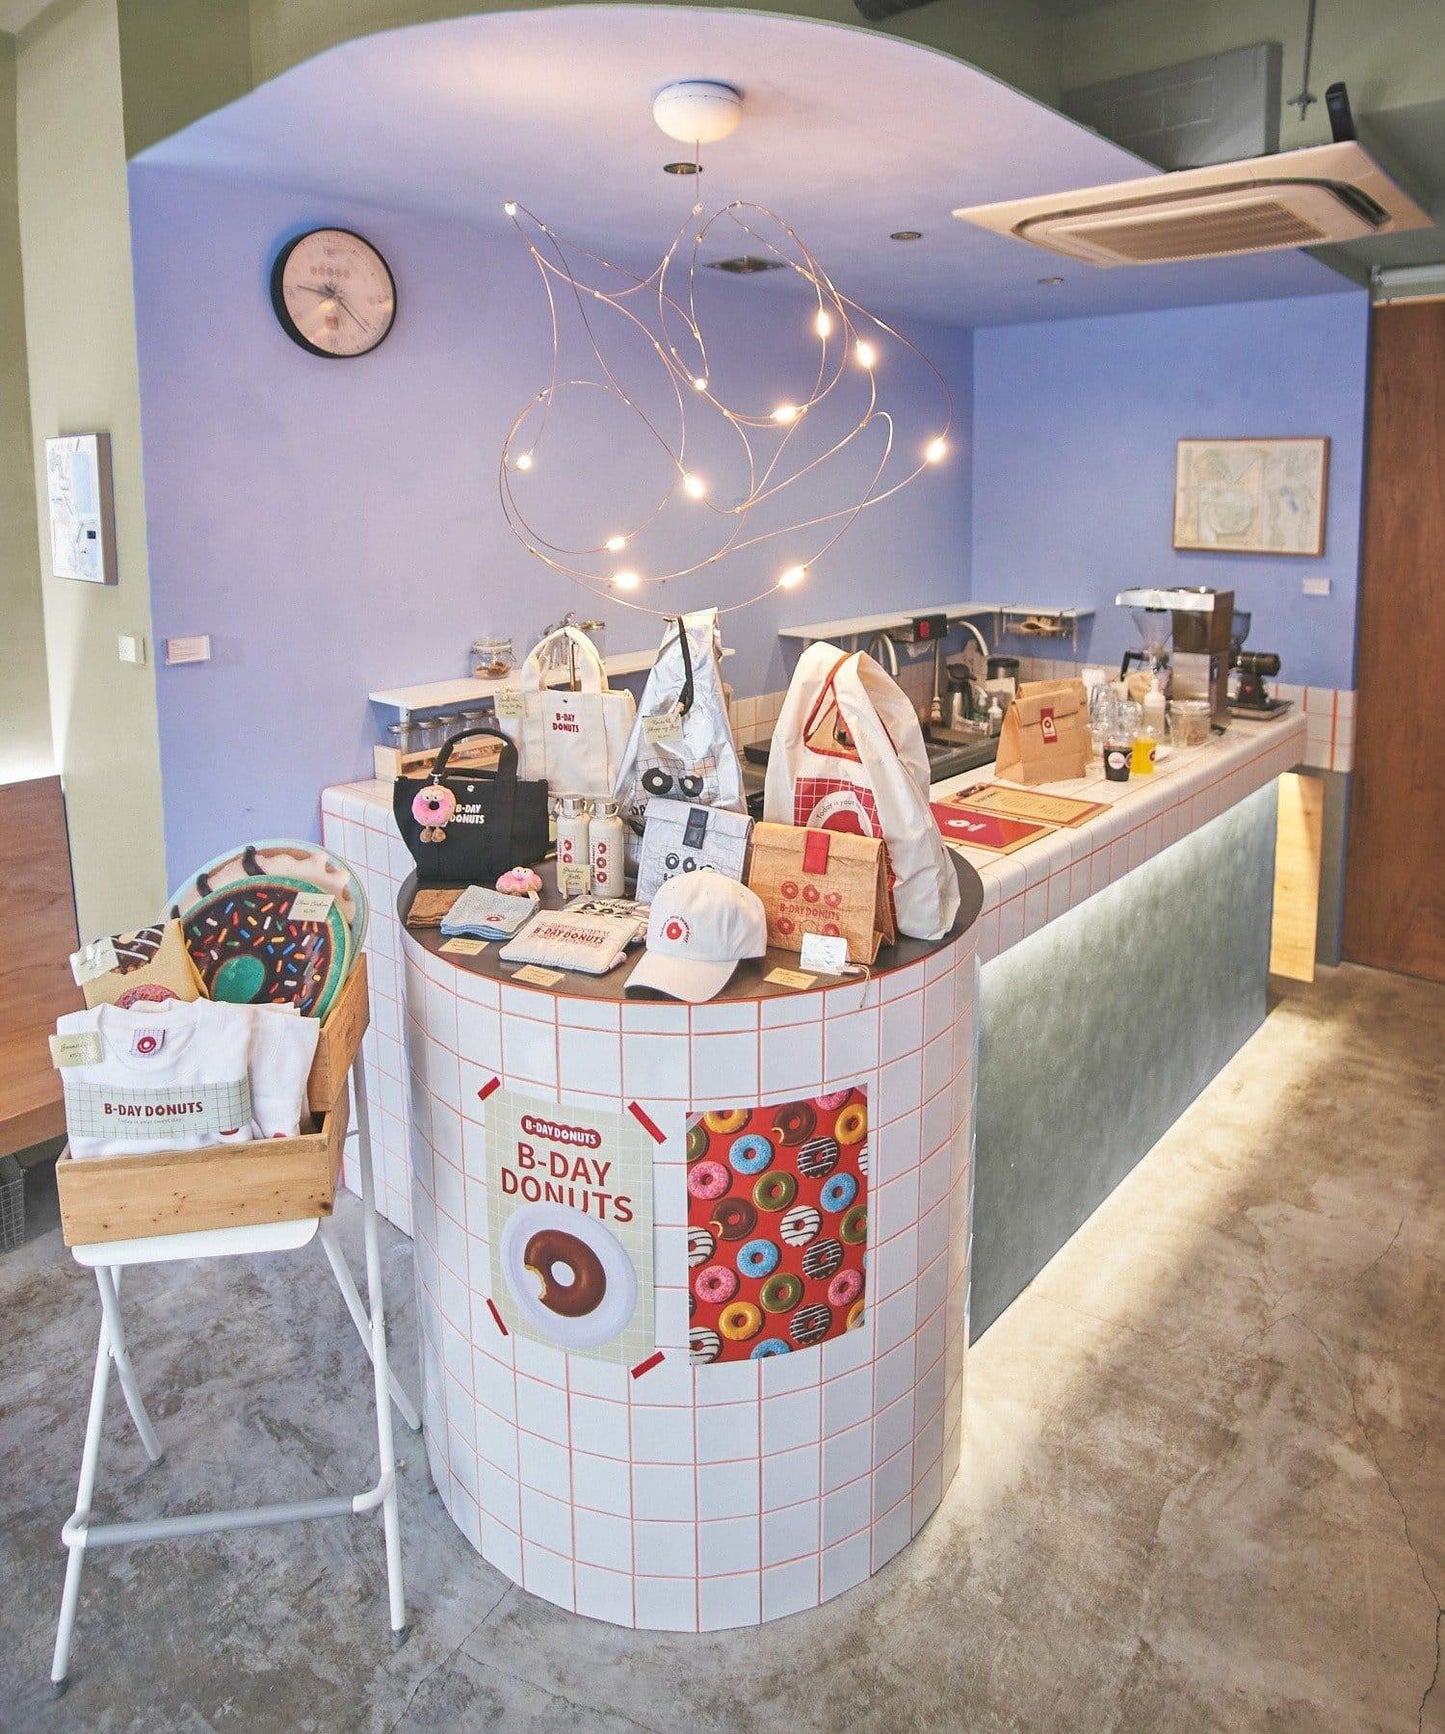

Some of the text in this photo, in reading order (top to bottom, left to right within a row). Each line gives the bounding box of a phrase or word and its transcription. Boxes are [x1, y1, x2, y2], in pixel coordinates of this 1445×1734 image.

[556, 713, 575, 722] B-DAY
[552, 722, 579, 733] DONUTS
[455, 803, 482, 813] B-DAY
[815, 802, 833, 821] Today
[449, 814, 486, 824] DONUTS
[779, 903, 840, 921] B-DAY DONUTS
[533, 926, 564, 938] B-DAY
[563, 932, 605, 944] DONUTS
[104, 1101, 203, 1117] B-DAY DONUTS
[525, 1119, 596, 1145] B-DAY DONUTS
[518, 1141, 611, 1187] B-DAY
[501, 1166, 634, 1222] DONUTS
